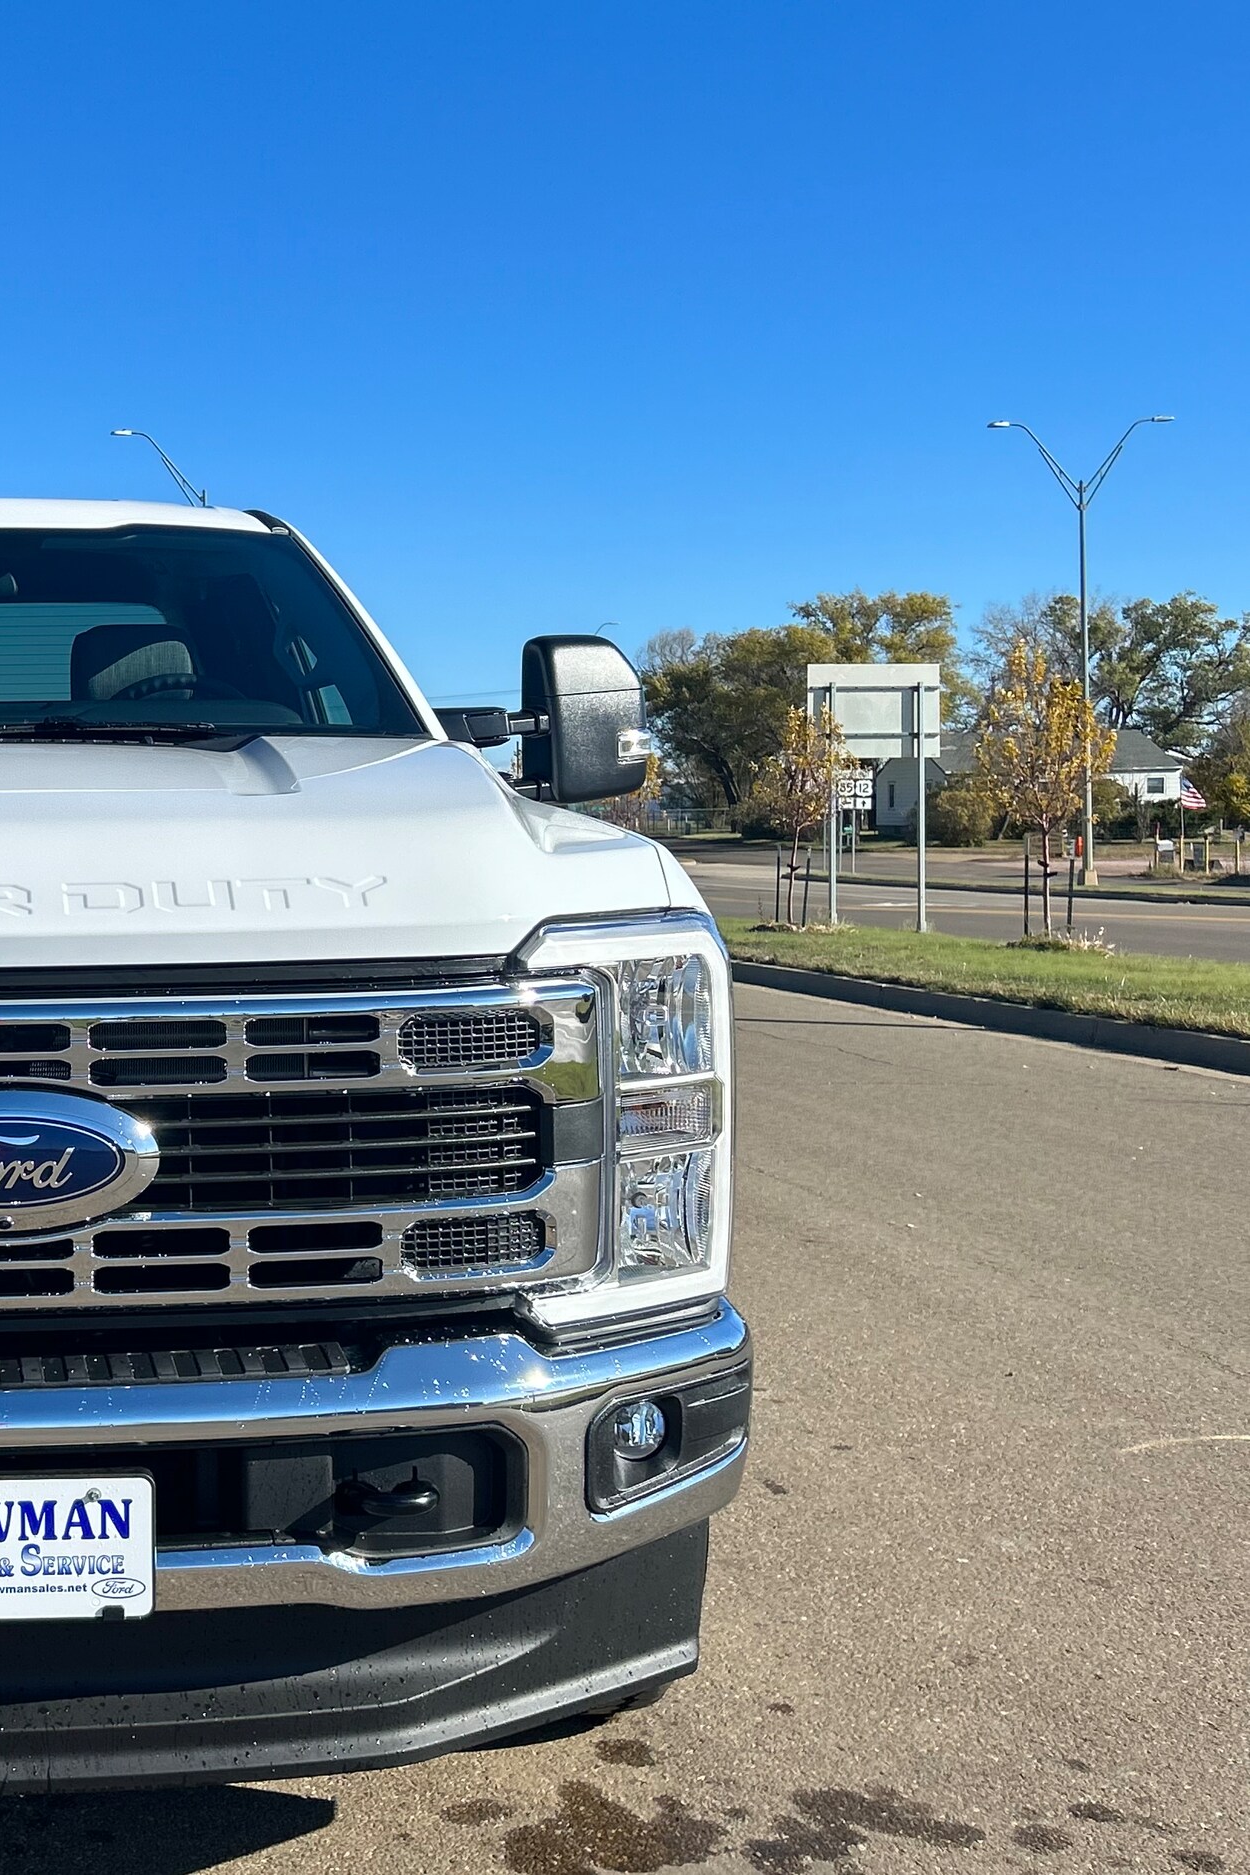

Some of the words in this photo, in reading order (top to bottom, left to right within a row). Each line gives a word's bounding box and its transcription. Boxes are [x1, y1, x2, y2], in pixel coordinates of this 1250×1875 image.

[859, 782, 870, 793] 12
[61, 875, 388, 915] DUTY
[20, 1543, 125, 1578] SERVICE
[101, 1579, 135, 1595] Ford
